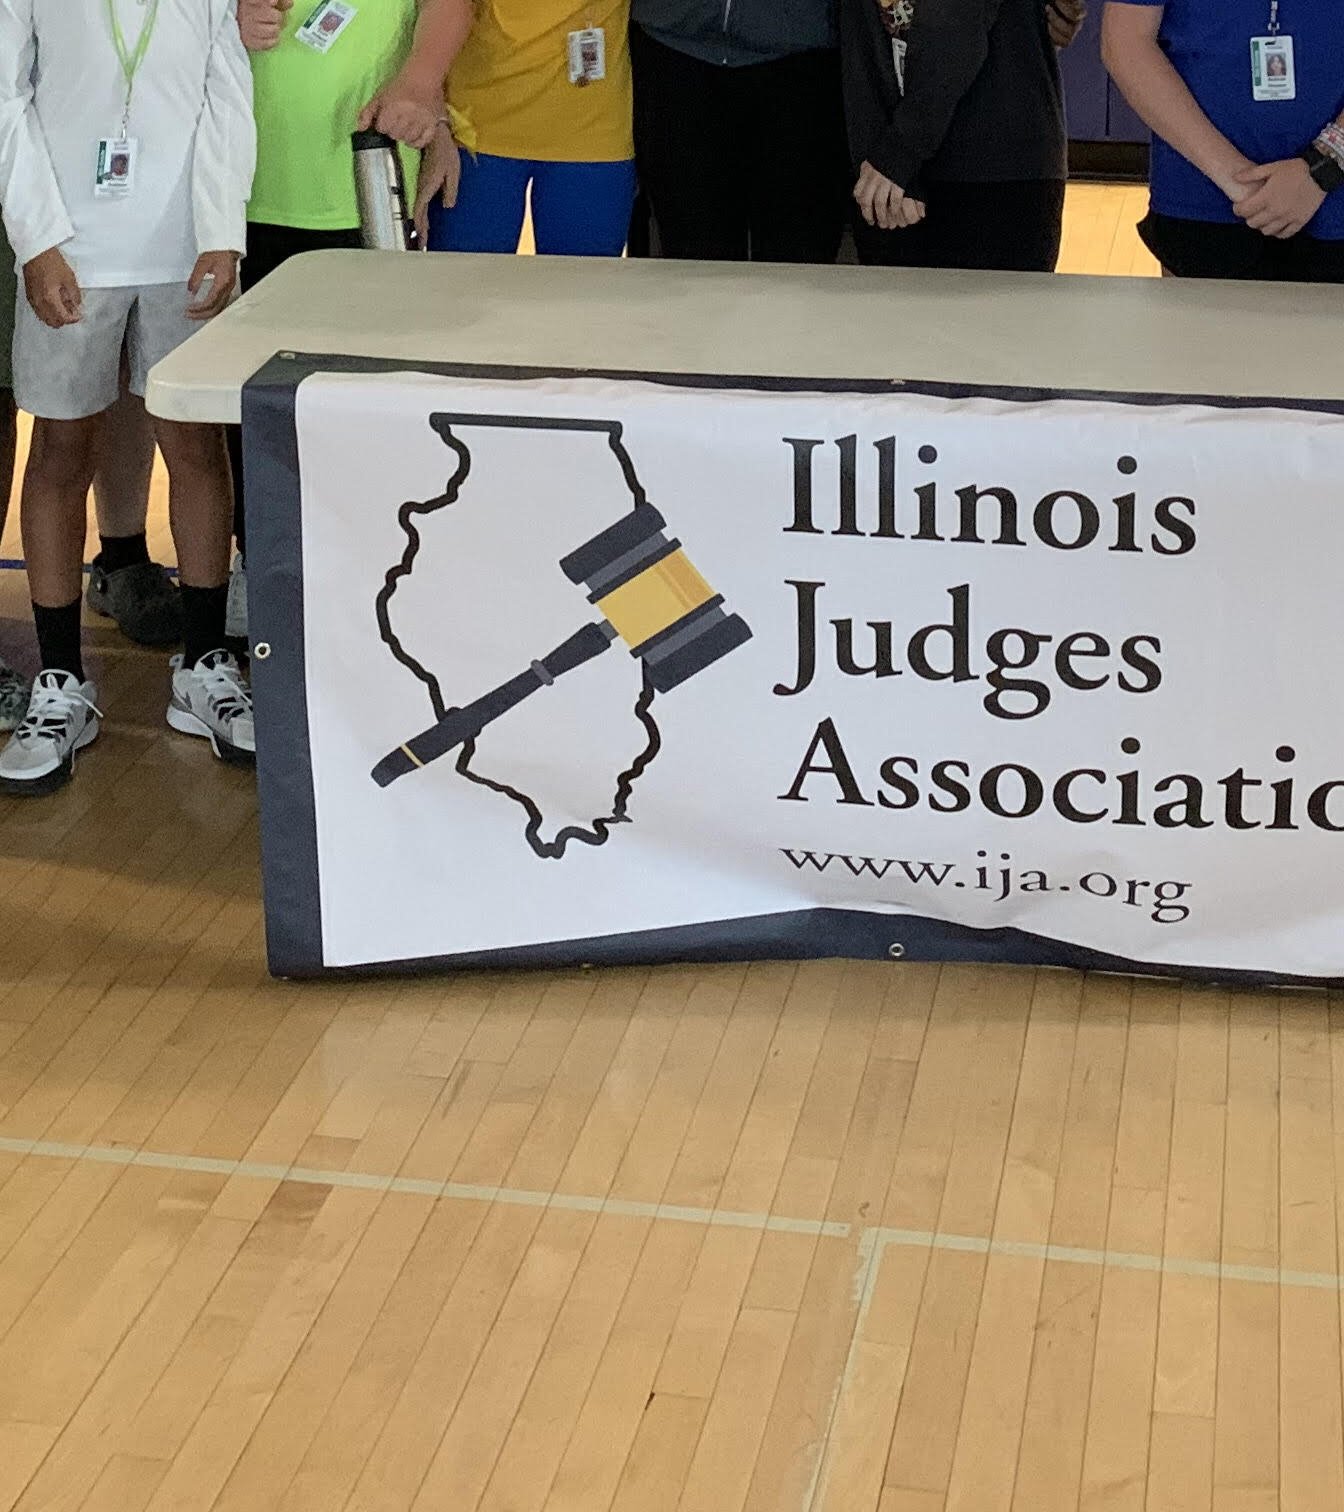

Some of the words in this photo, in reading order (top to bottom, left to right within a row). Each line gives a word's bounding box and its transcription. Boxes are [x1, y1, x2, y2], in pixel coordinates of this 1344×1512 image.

[781, 433, 1197, 557] Illinois
[771, 578, 1163, 721] Judges
[778, 848, 1194, 924] www.ija.org
